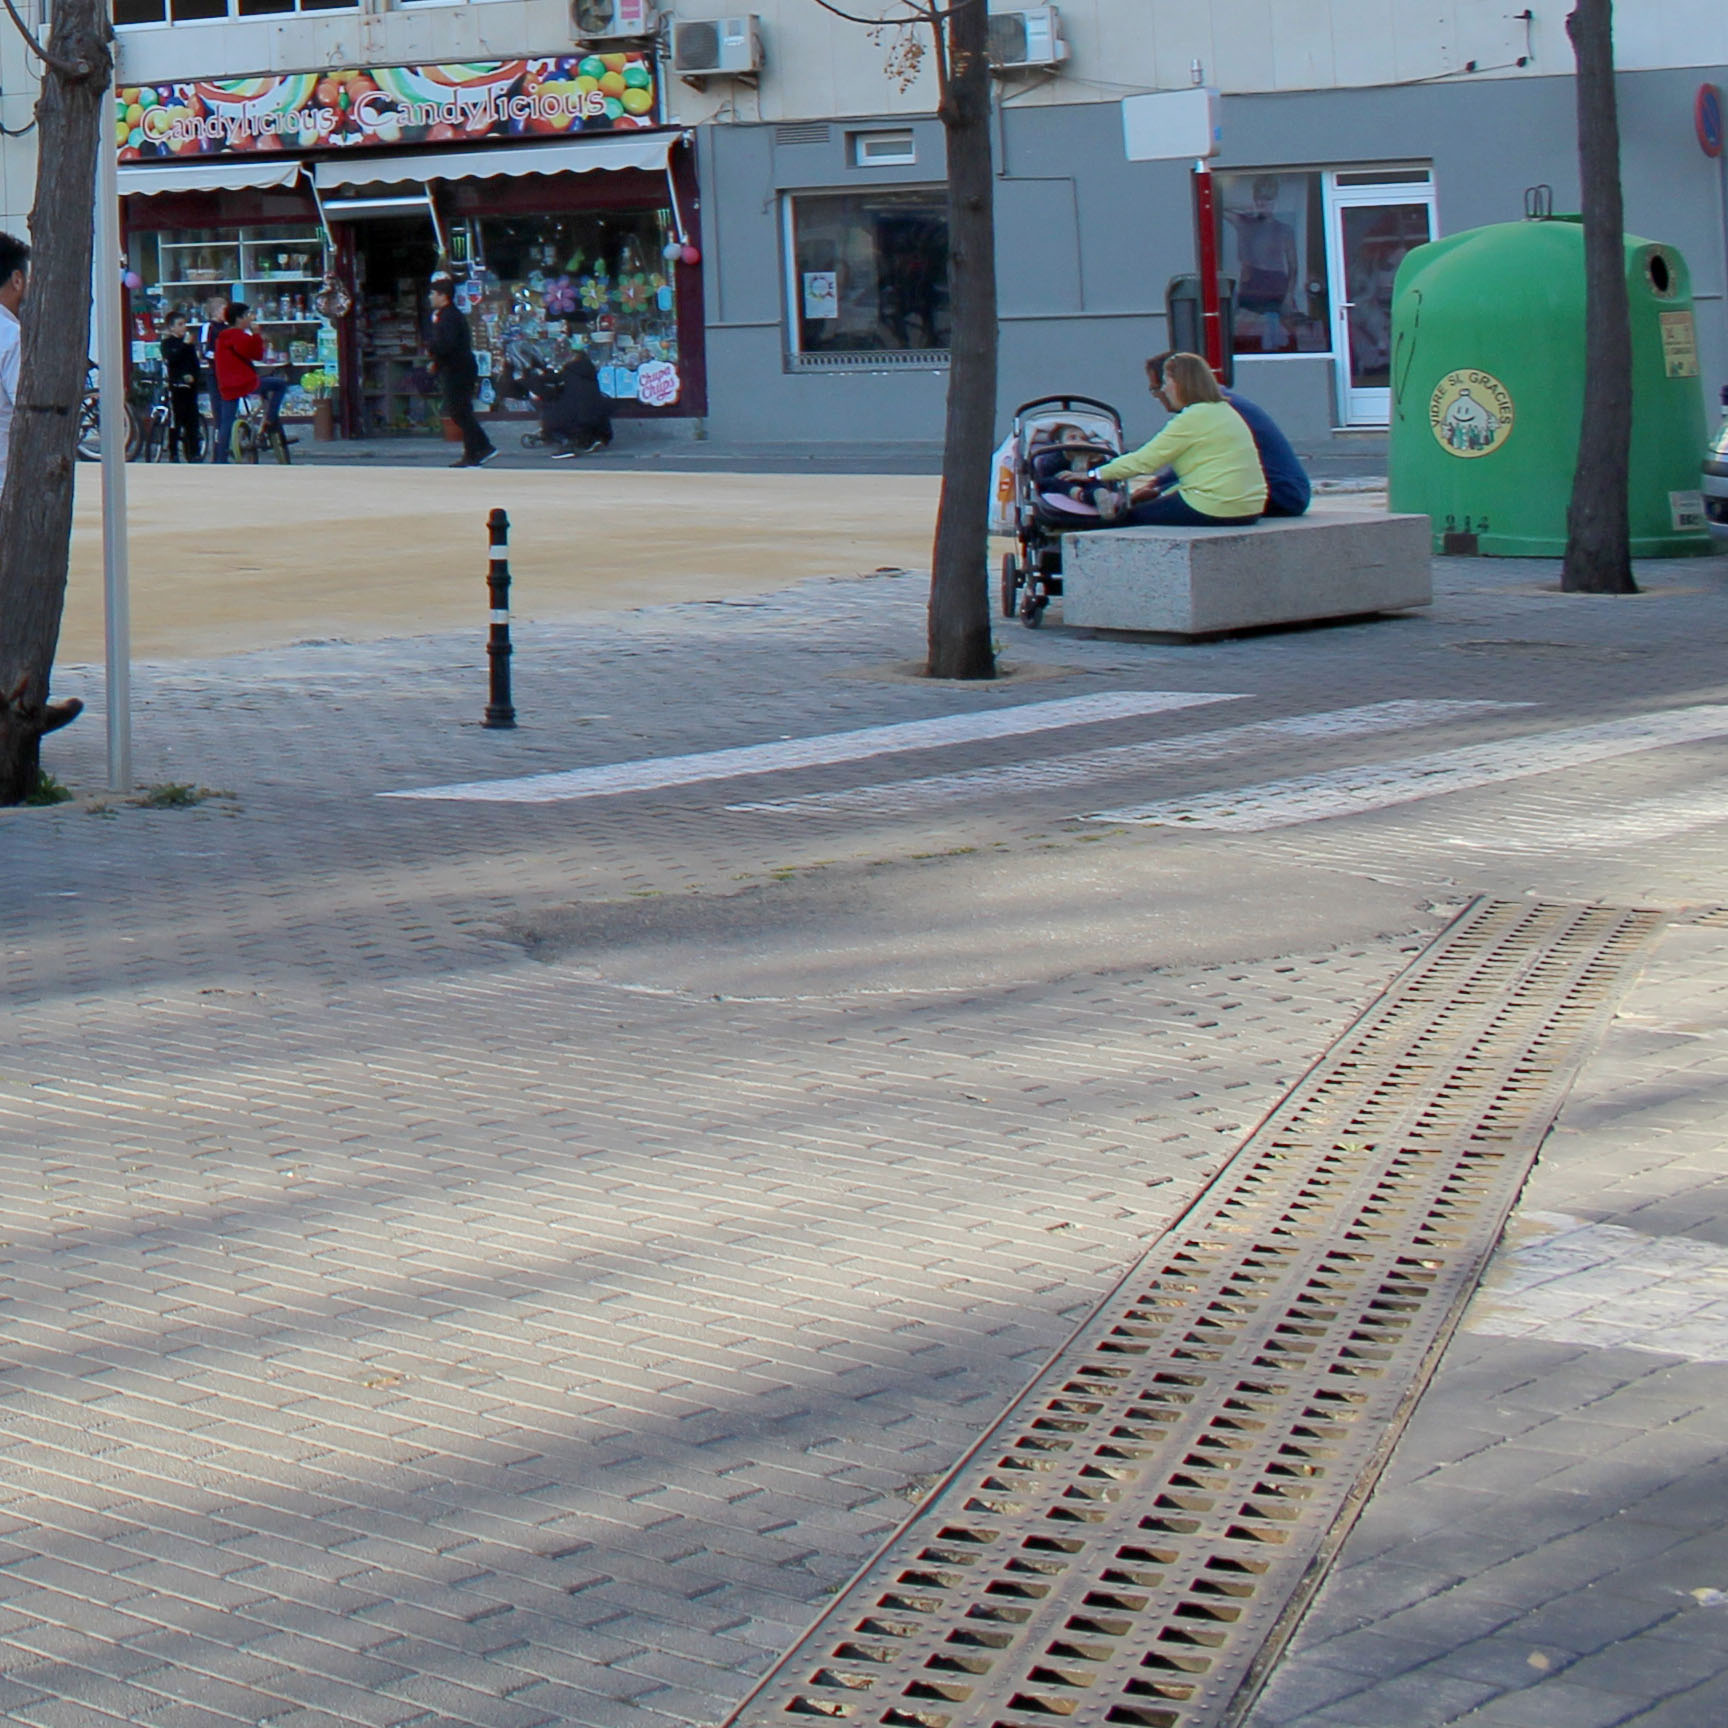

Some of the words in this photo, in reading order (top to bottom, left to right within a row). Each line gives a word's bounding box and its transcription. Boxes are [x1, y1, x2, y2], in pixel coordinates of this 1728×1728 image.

[140, 100, 337, 144] Candylicious
[354, 83, 607, 133] Candylicious
[639, 366, 671, 387] Chupa
[1430, 388, 1447, 428] VIDRE
[1468, 371, 1512, 425] GRACIES
